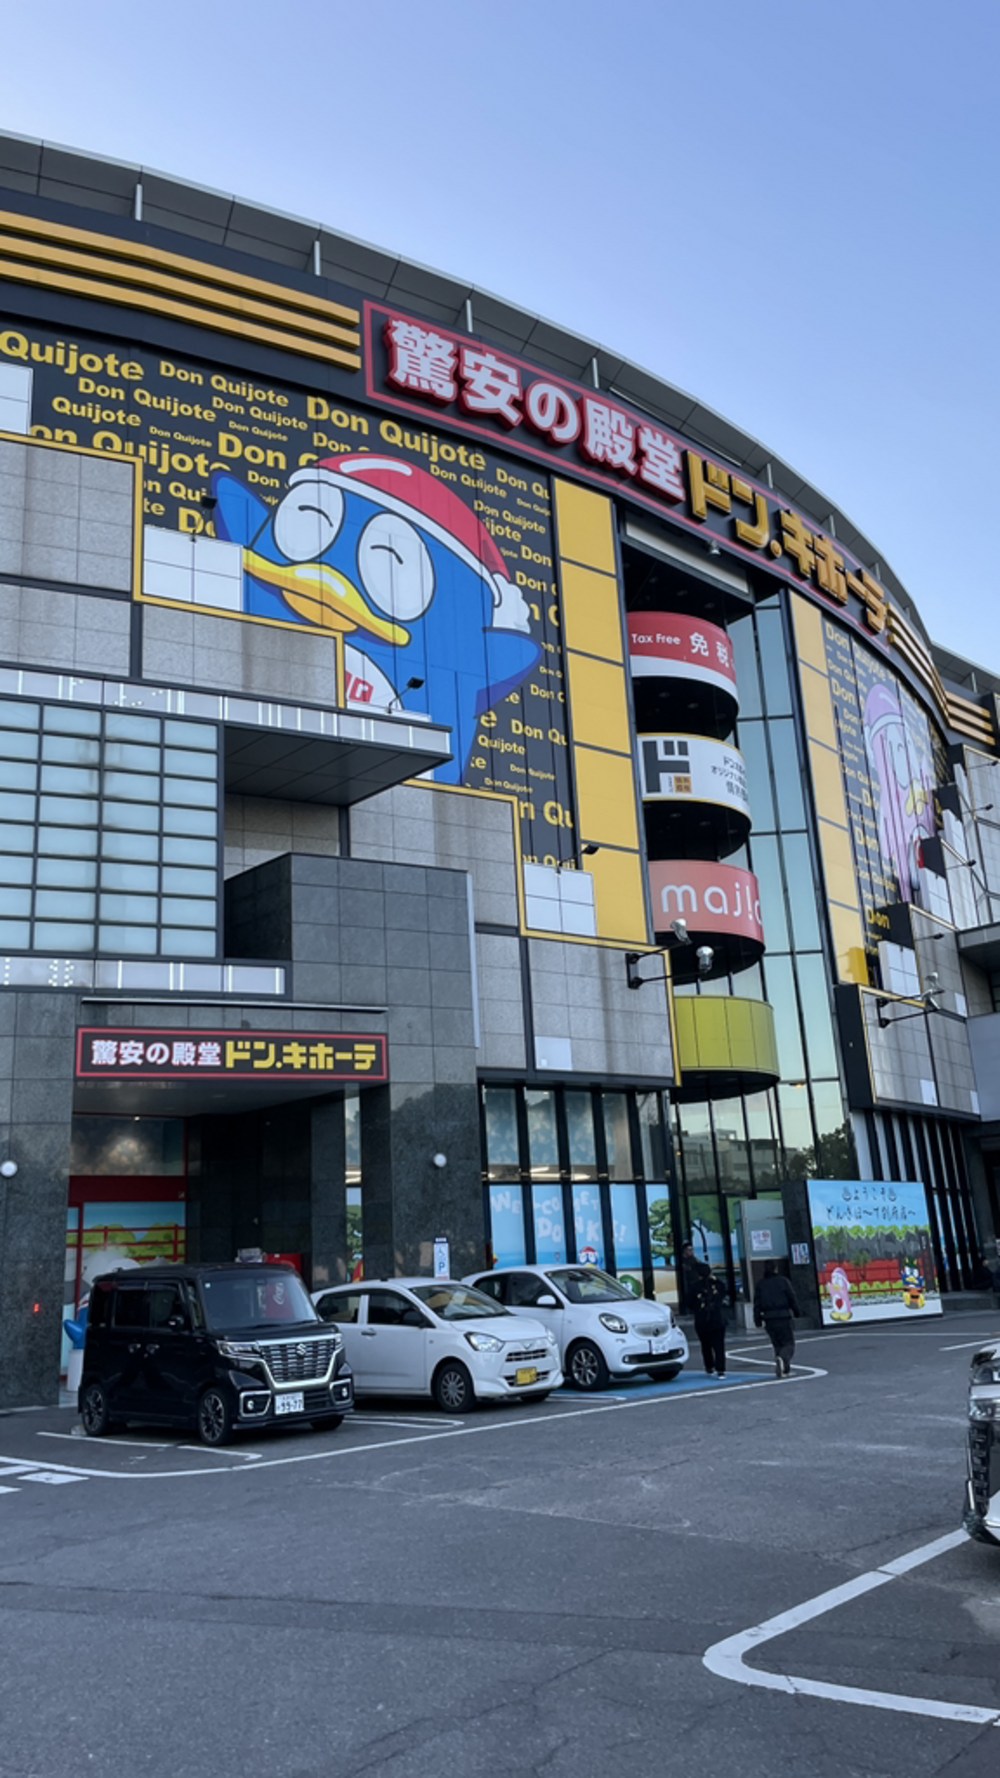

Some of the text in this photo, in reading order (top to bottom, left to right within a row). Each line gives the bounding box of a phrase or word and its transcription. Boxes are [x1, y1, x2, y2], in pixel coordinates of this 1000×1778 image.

[0, 331, 144, 381] Quijote
[160, 360, 289, 407] Don Quijote
[52, 396, 141, 426] Quijote
[78, 377, 216, 422] Don Quijote
[212, 396, 308, 431] Don Quijote
[149, 425, 171, 438] Don
[228, 420, 249, 432] Don
[307, 396, 486, 471] Don Quijote
[218, 431, 287, 470] Don
[247, 470, 280, 488] Don
[430, 464, 508, 498] Don Quijote
[496, 468, 527, 491] Don
[474, 500, 546, 534] Don Quijote
[520, 545, 552, 567] Don
[515, 571, 547, 592] Don
[631, 633, 654, 644] Tax
[656, 633, 681, 645] Free
[530, 683, 555, 700] Don
[511, 719, 544, 740] Don
[478, 734, 526, 756] Quijote
[642, 740, 690, 793] ド
[864, 906, 891, 930] Don
[438, 1261, 446, 1273] P
